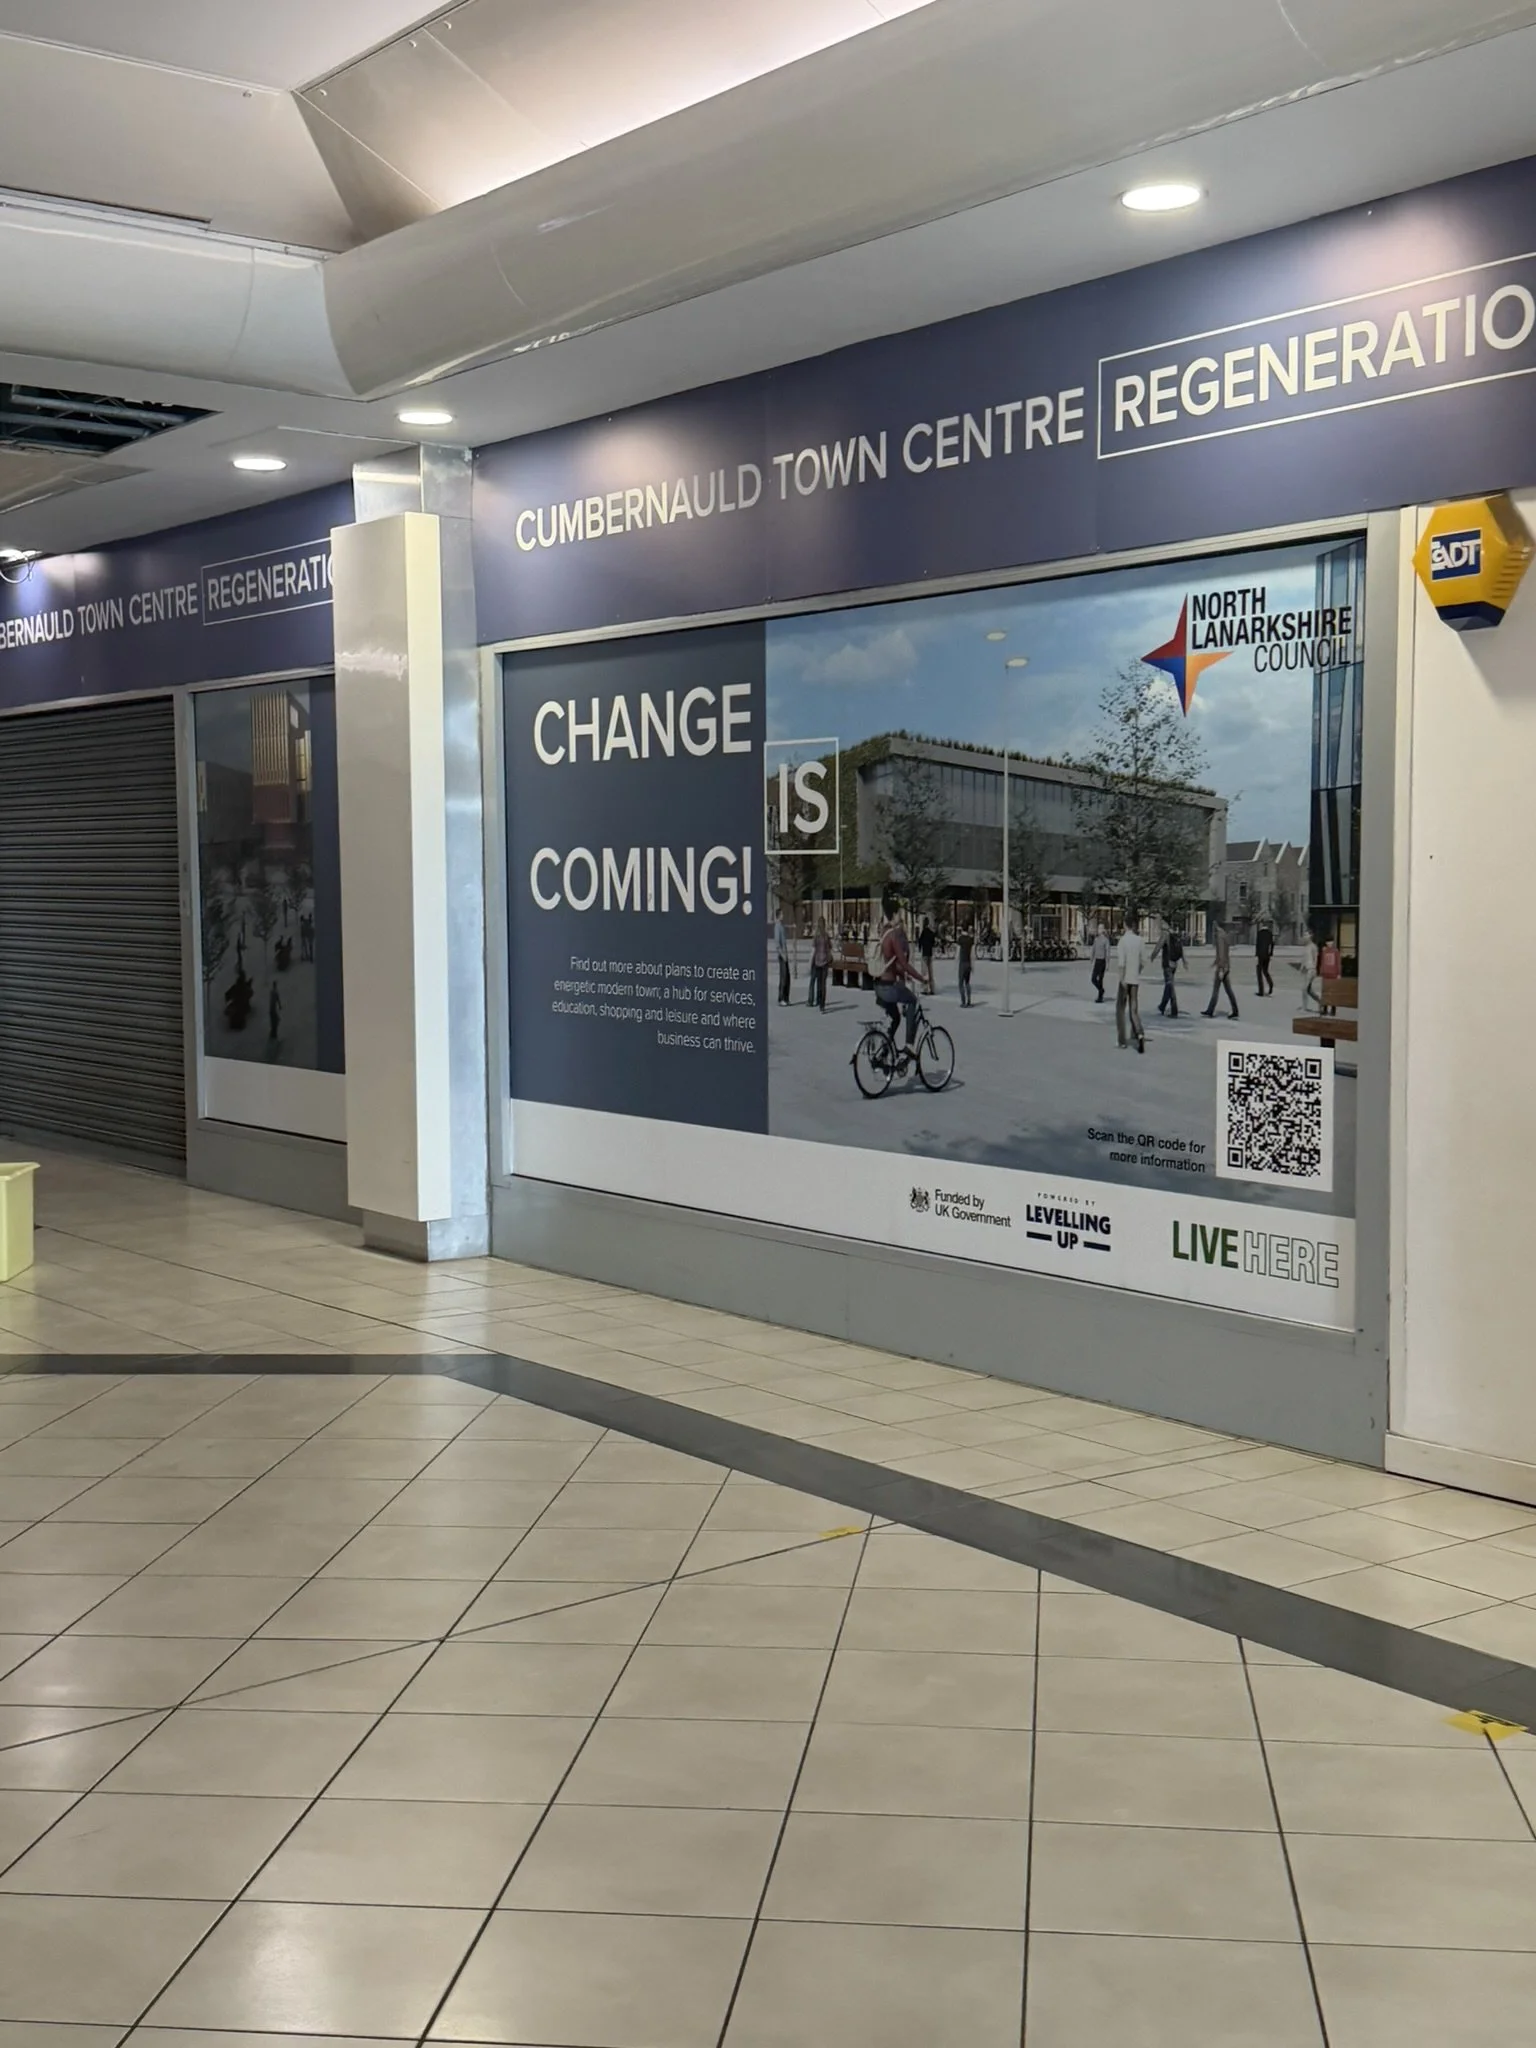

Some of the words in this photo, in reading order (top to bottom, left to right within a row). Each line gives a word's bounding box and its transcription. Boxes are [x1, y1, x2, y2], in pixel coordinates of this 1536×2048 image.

[515, 463, 761, 550] CUMBERNAULD
[773, 431, 887, 499] TOWN
[903, 387, 1084, 473] CENTRE
[1115, 284, 1536, 432] REGENERATIO
[77, 597, 124, 635] TOWN
[129, 583, 198, 625] CENTRE
[1192, 587, 1266, 621] NORTH
[1192, 606, 1352, 649] LANARKSHIRE
[1254, 635, 1351, 672] COUNCIL
[533, 683, 751, 765] CHANGE
[778, 760, 829, 833] IS
[530, 846, 752, 915] COMING!
[570, 956, 590, 971] Find
[592, 960, 607, 972] out
[609, 961, 633, 974] more
[635, 961, 663, 976] about
[665, 962, 692, 979] plans
[694, 965, 705, 978] to
[706, 966, 740, 980] create
[742, 968, 756, 981] an
[597, 982, 634, 995] modern
[663, 987, 670, 999] a
[672, 985, 692, 1000] hub
[694, 986, 708, 1001] for
[599, 1003, 643, 1023] shopping
[645, 1007, 663, 1021] and
[665, 1008, 699, 1024] leisure
[701, 1011, 720, 1026] and
[723, 1013, 756, 1029] where
[657, 1030, 700, 1048] business
[703, 1037, 722, 1049] can
[724, 1037, 756, 1053] thrive.
[1087, 1127, 1114, 1142] Scan
[1117, 1132, 1134, 1145] the
[1137, 1134, 1155, 1148] QR
[1158, 1139, 1186, 1152] code
[1189, 1140, 1206, 1154] for
[1109, 1151, 1138, 1163] more
[1140, 1154, 1206, 1173] information
[935, 1188, 971, 1205] Funded
[972, 1194, 985, 1211] by
[1037, 1192, 1079, 1204] POWERED
[935, 1203, 950, 1217] UK
[951, 1206, 1012, 1228] Government
[1026, 1204, 1111, 1235] LEVELLING
[1057, 1230, 1079, 1249] UP
